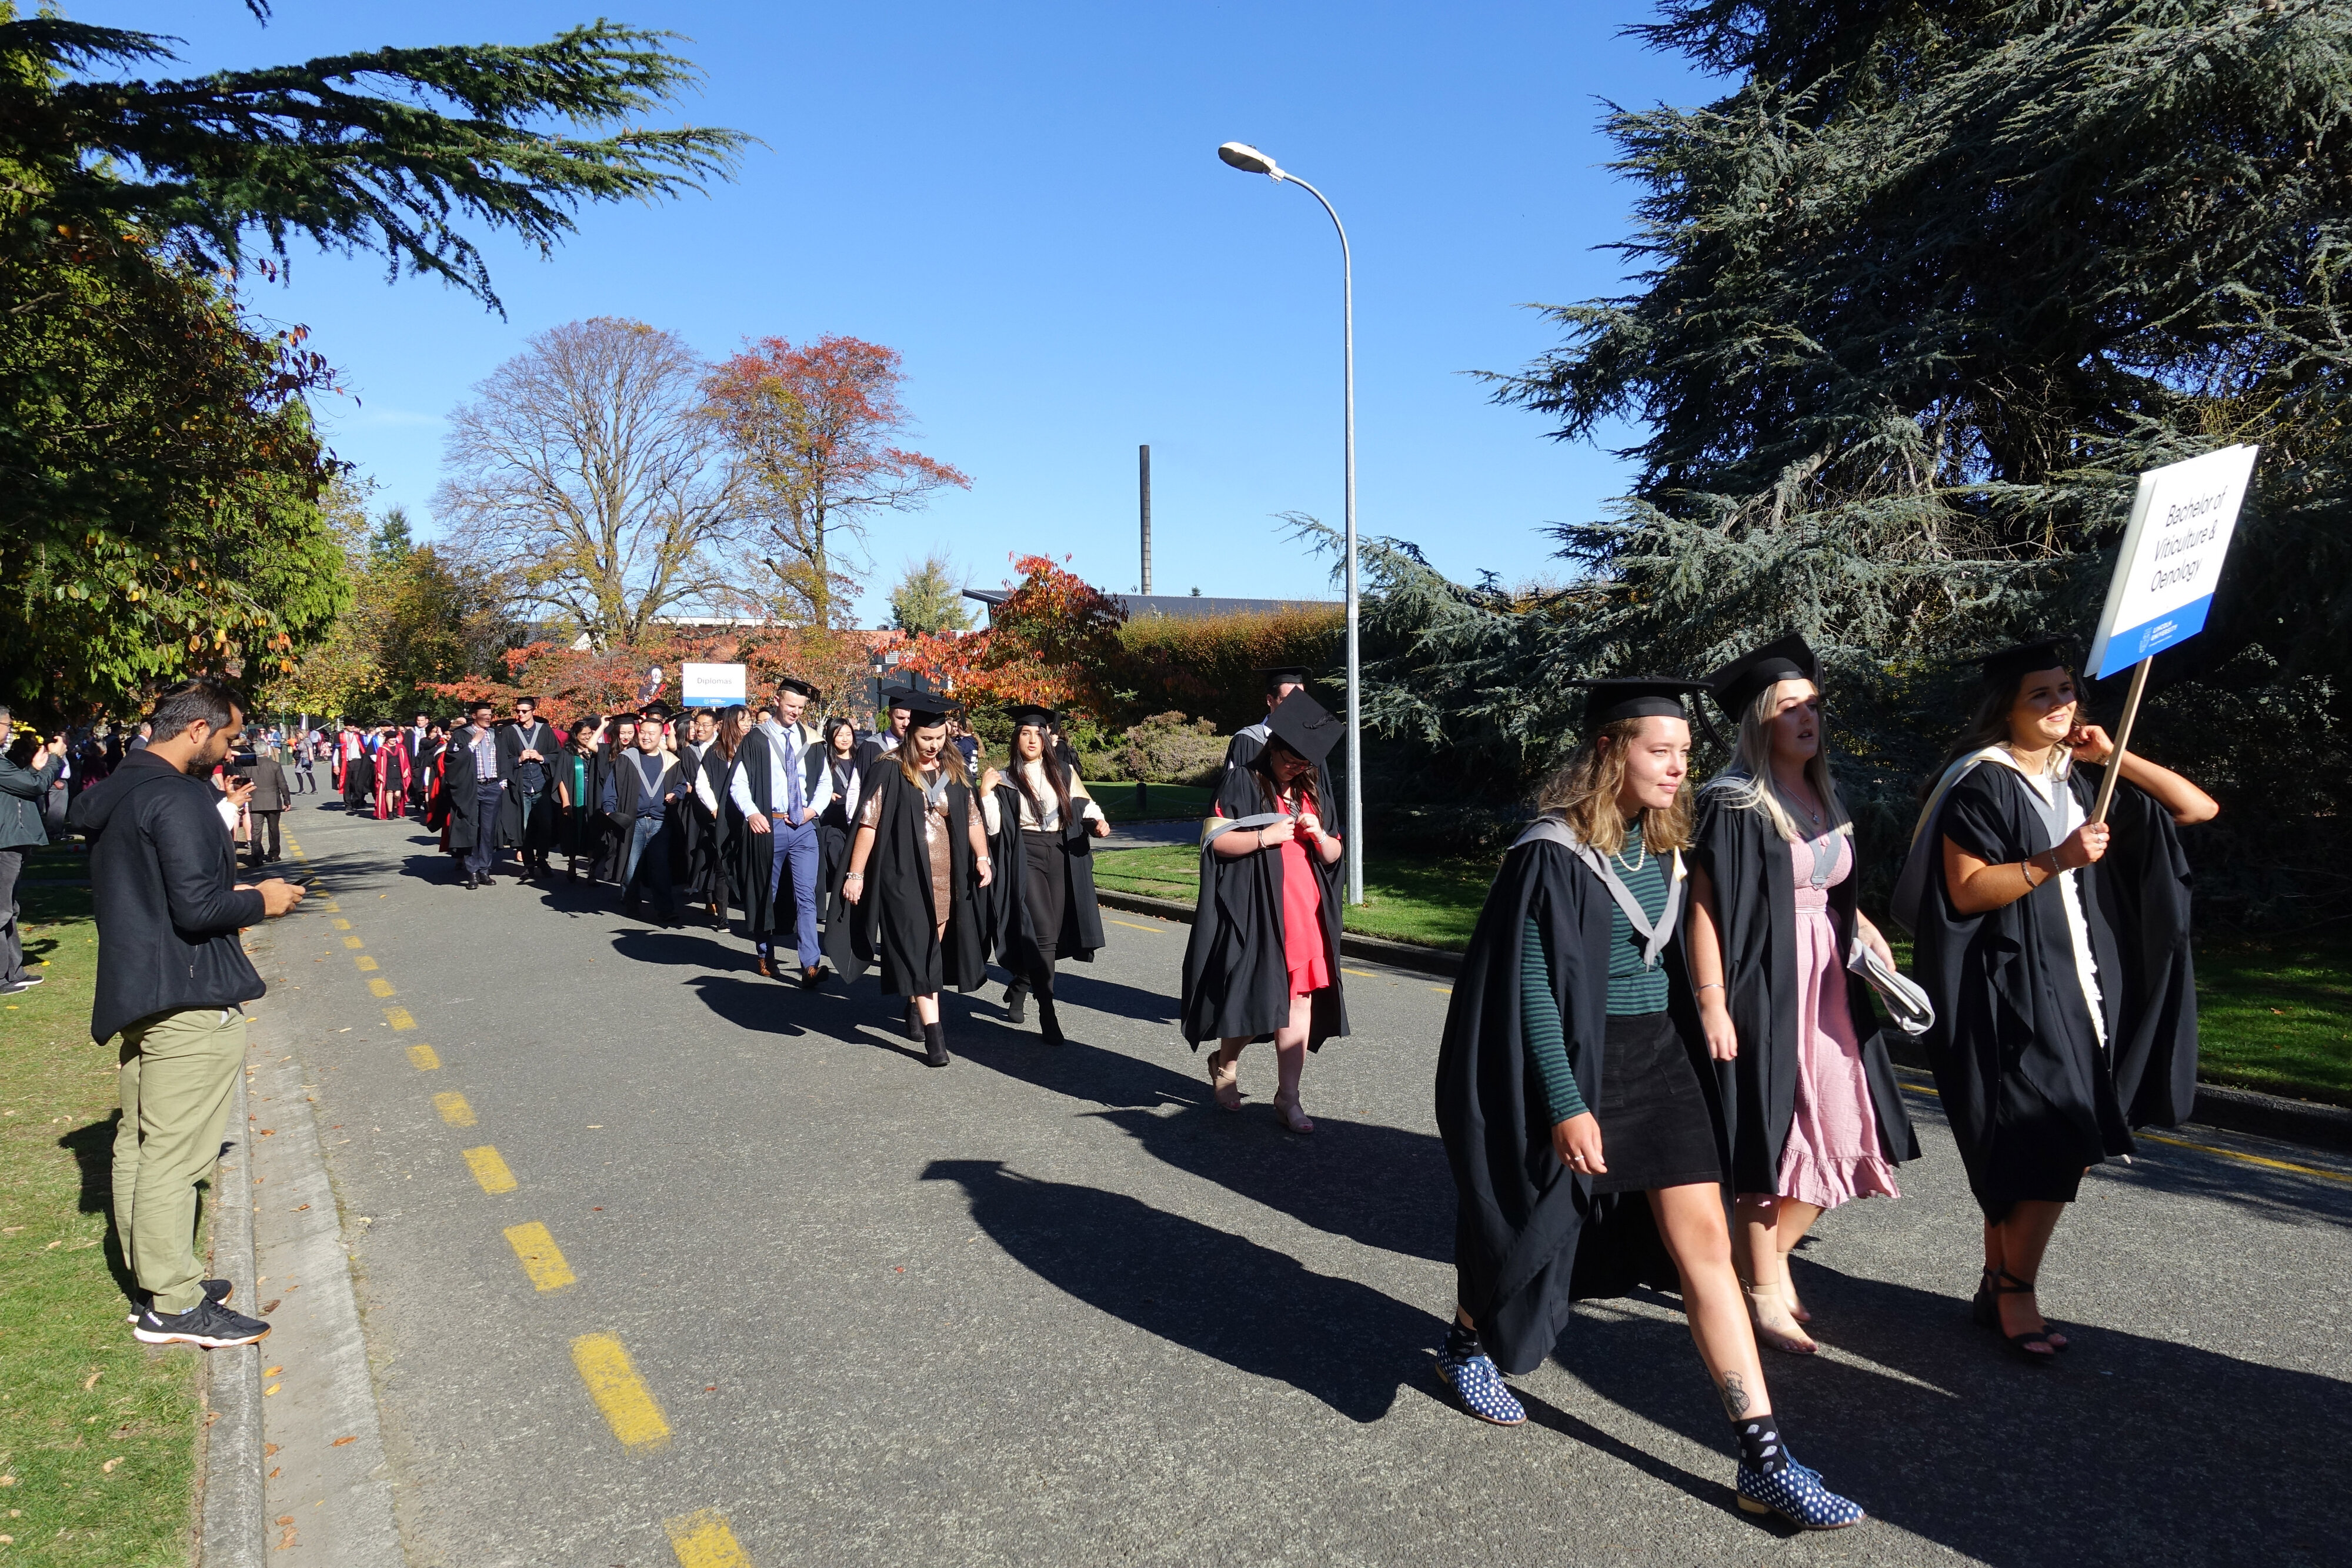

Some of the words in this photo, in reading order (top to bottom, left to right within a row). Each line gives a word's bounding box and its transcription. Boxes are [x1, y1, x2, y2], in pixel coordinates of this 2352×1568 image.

[2166, 493, 2213, 527] Bachelor
[2213, 485, 2228, 510] of
[2154, 528, 2208, 562] Viticulture
[2208, 519, 2218, 541] &
[2151, 558, 2203, 592] Oenology
[147, 1312, 164, 1327] Reebok
